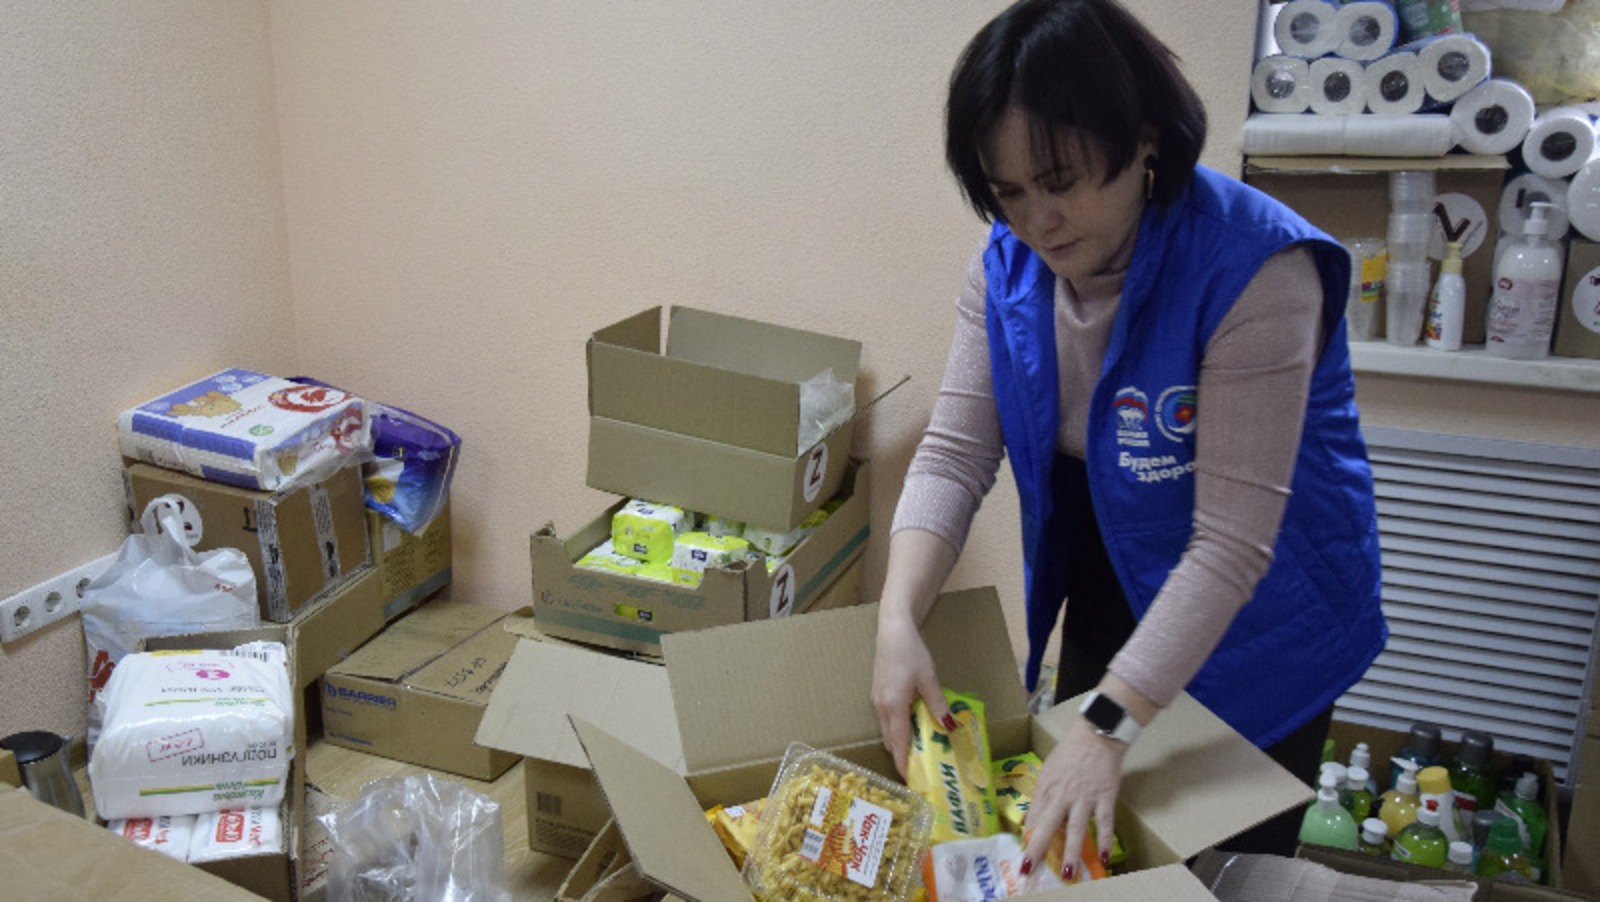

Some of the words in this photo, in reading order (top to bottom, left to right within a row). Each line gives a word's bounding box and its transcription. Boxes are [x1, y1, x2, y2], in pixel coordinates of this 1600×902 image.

[810, 449, 823, 487] Z
[1118, 451, 1177, 473] Будем
[775, 570, 789, 612] Z
[337, 687, 397, 708] BARRIER
[181, 748, 277, 767] ПОДГУЗНИКИ
[939, 762, 969, 834] ВАФЛИ
